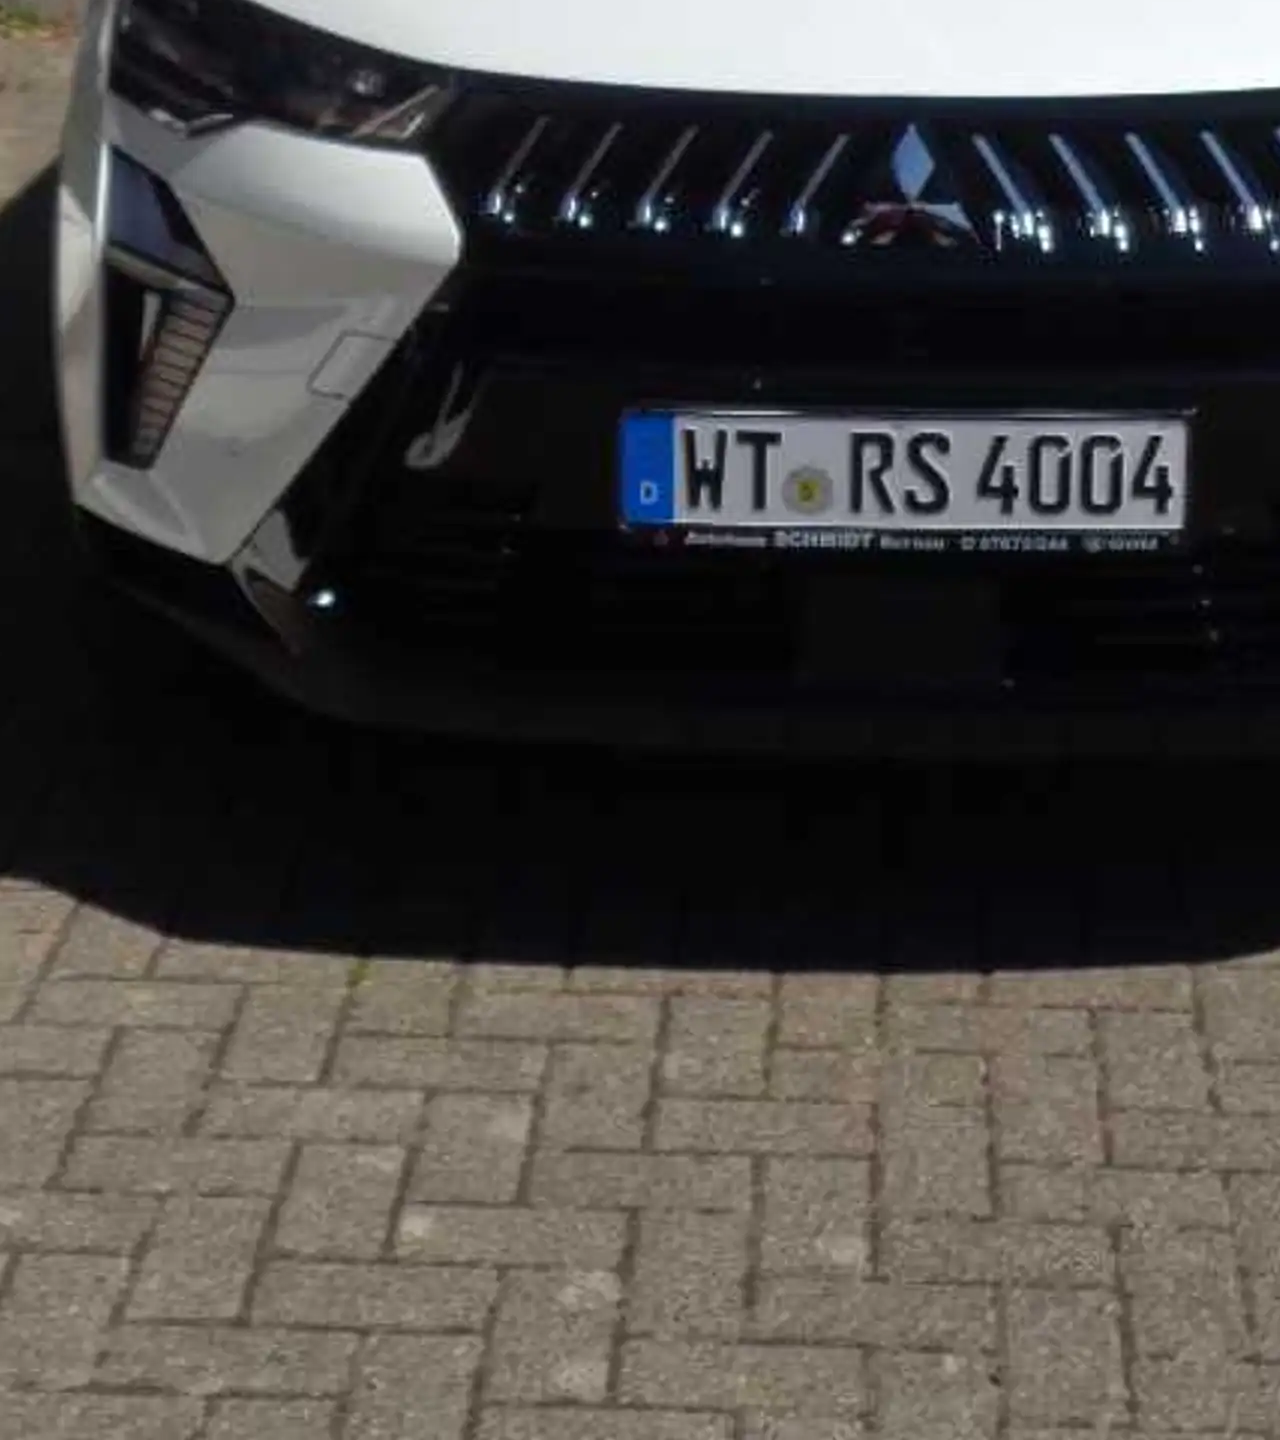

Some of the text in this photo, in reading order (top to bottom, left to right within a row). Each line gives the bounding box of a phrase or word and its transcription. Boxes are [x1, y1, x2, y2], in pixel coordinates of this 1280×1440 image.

[639, 480, 658, 504] D
[682, 428, 1174, 515] WT RS 4004
